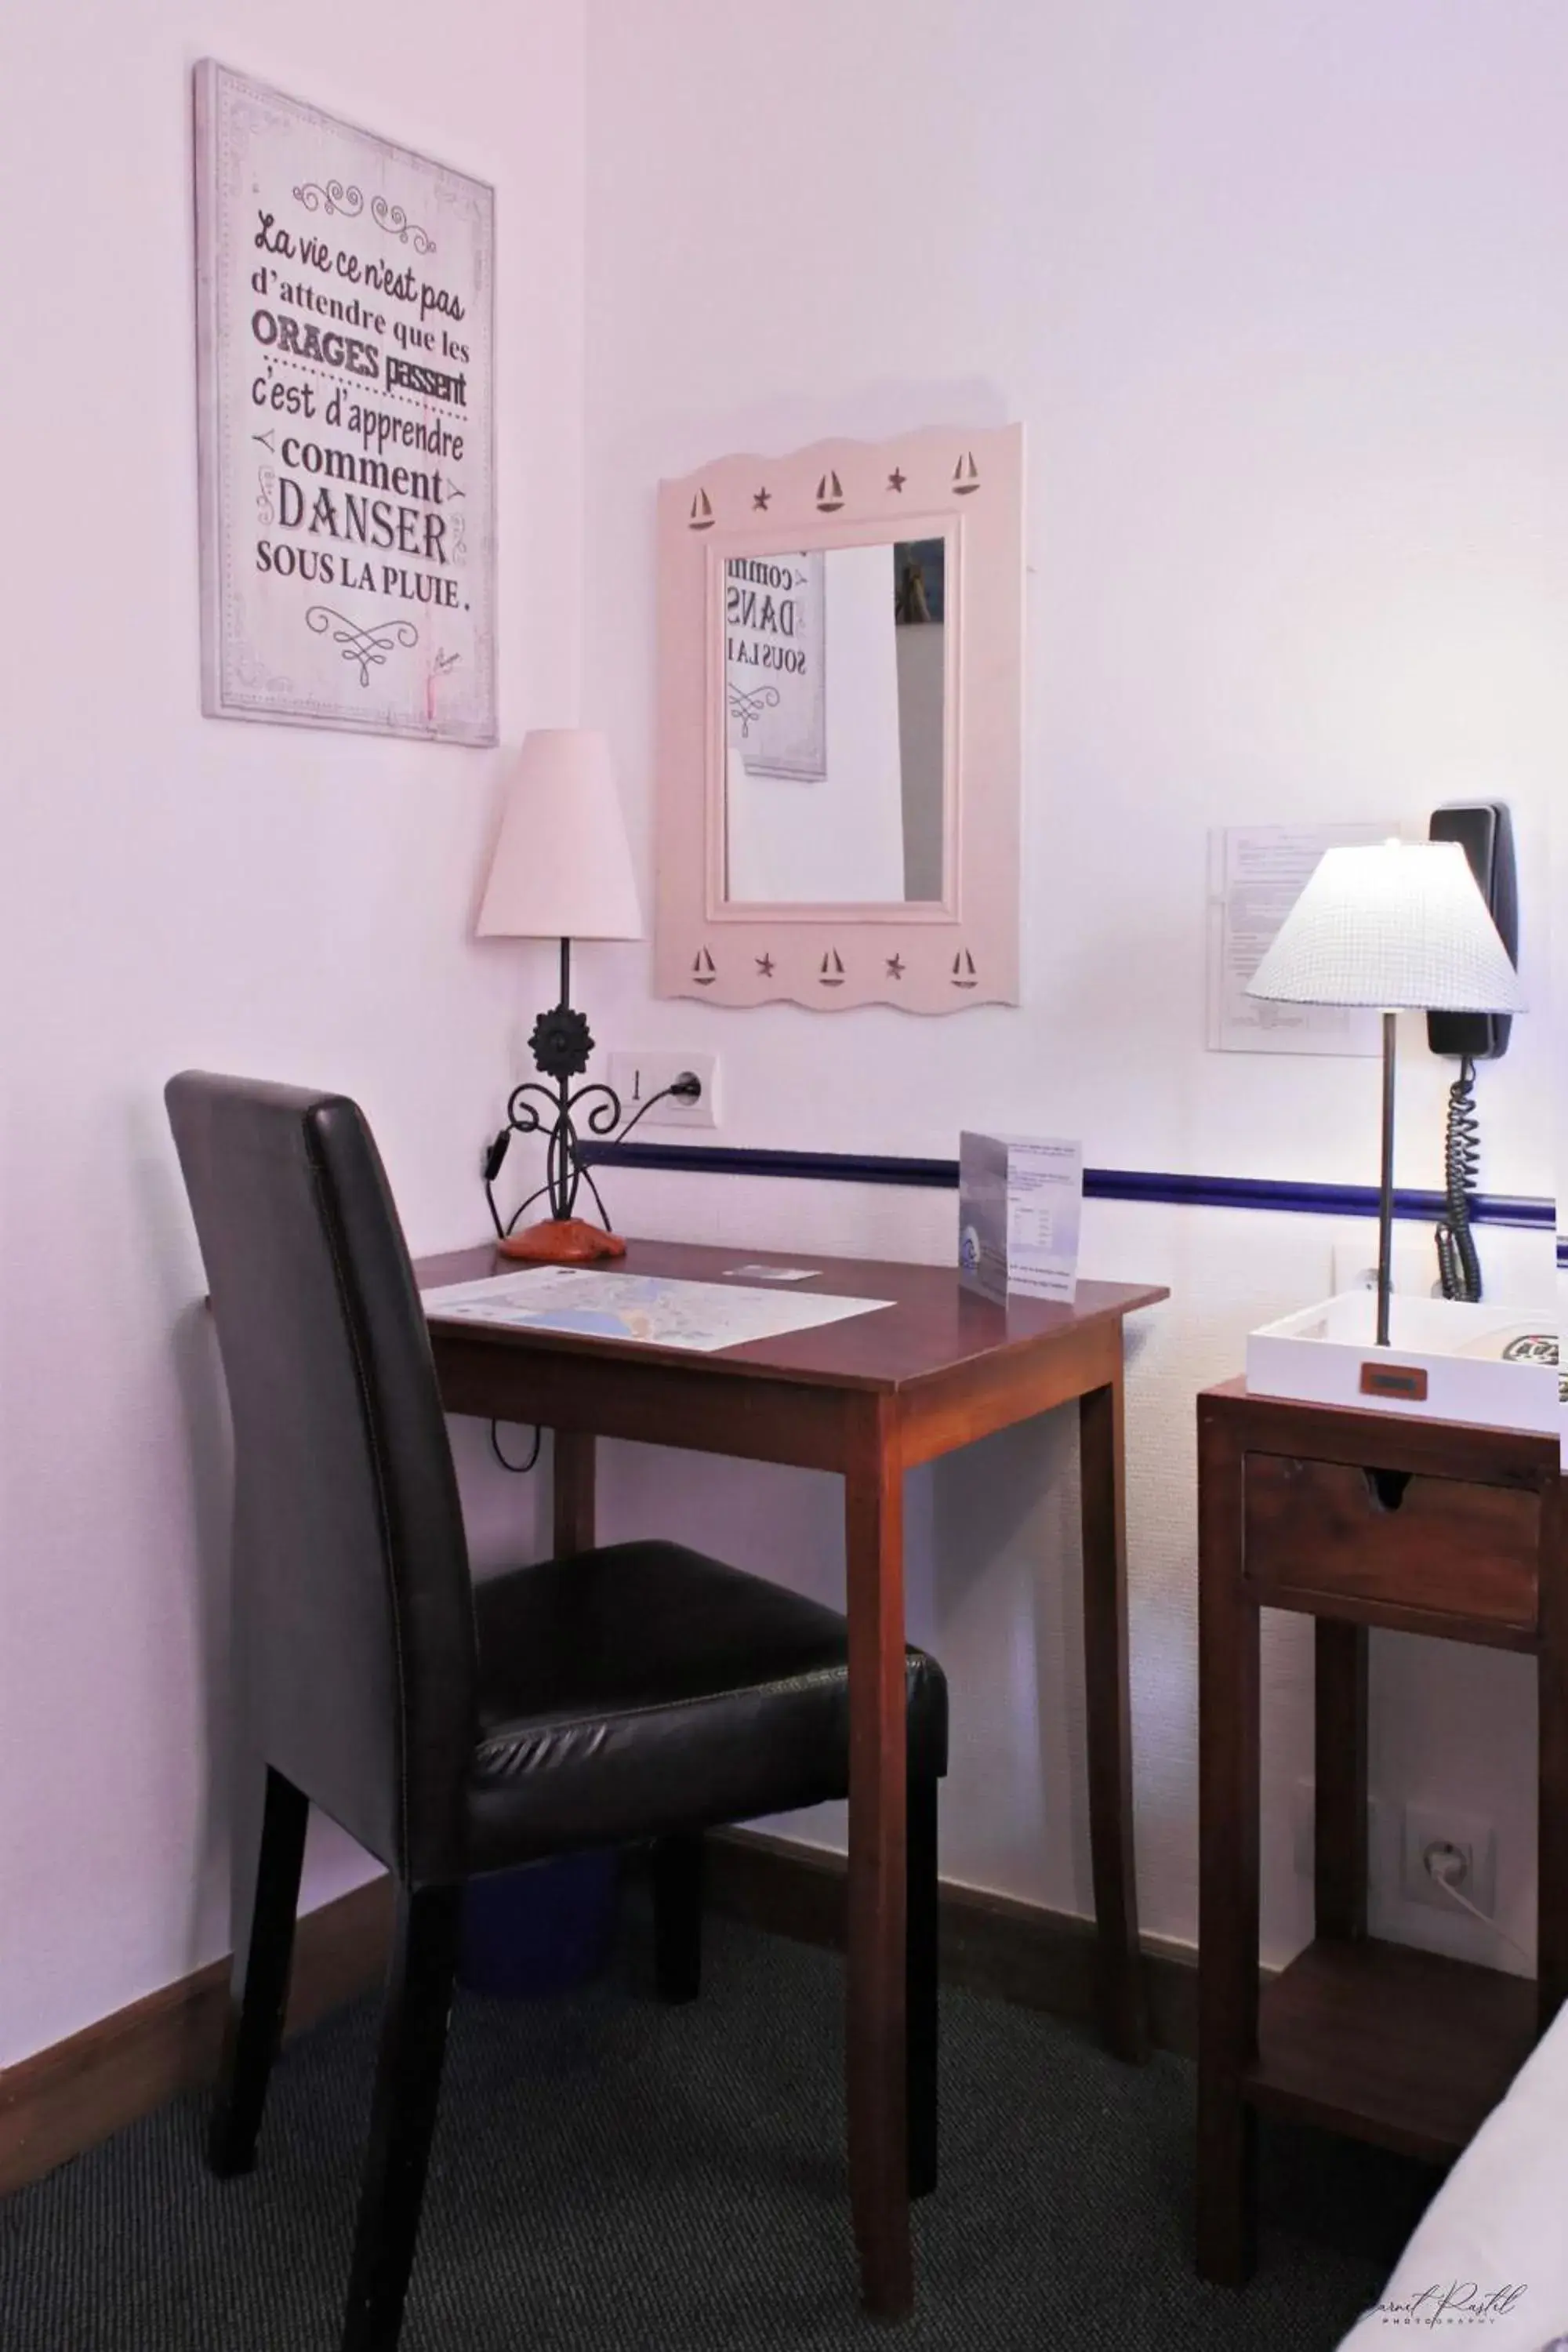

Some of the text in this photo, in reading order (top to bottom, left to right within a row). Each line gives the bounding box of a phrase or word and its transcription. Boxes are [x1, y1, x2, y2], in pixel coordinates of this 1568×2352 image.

[254, 209, 466, 322] La vie ce n'est pas
[251, 309, 467, 406] ORAGES passent
[252, 267, 470, 364] d'attendre que les
[251, 365, 464, 461] c'est d'apprendre
[281, 437, 444, 505] comment
[256, 539, 335, 584] SOUS
[340, 557, 376, 593] LA
[278, 476, 447, 564] DANSER
